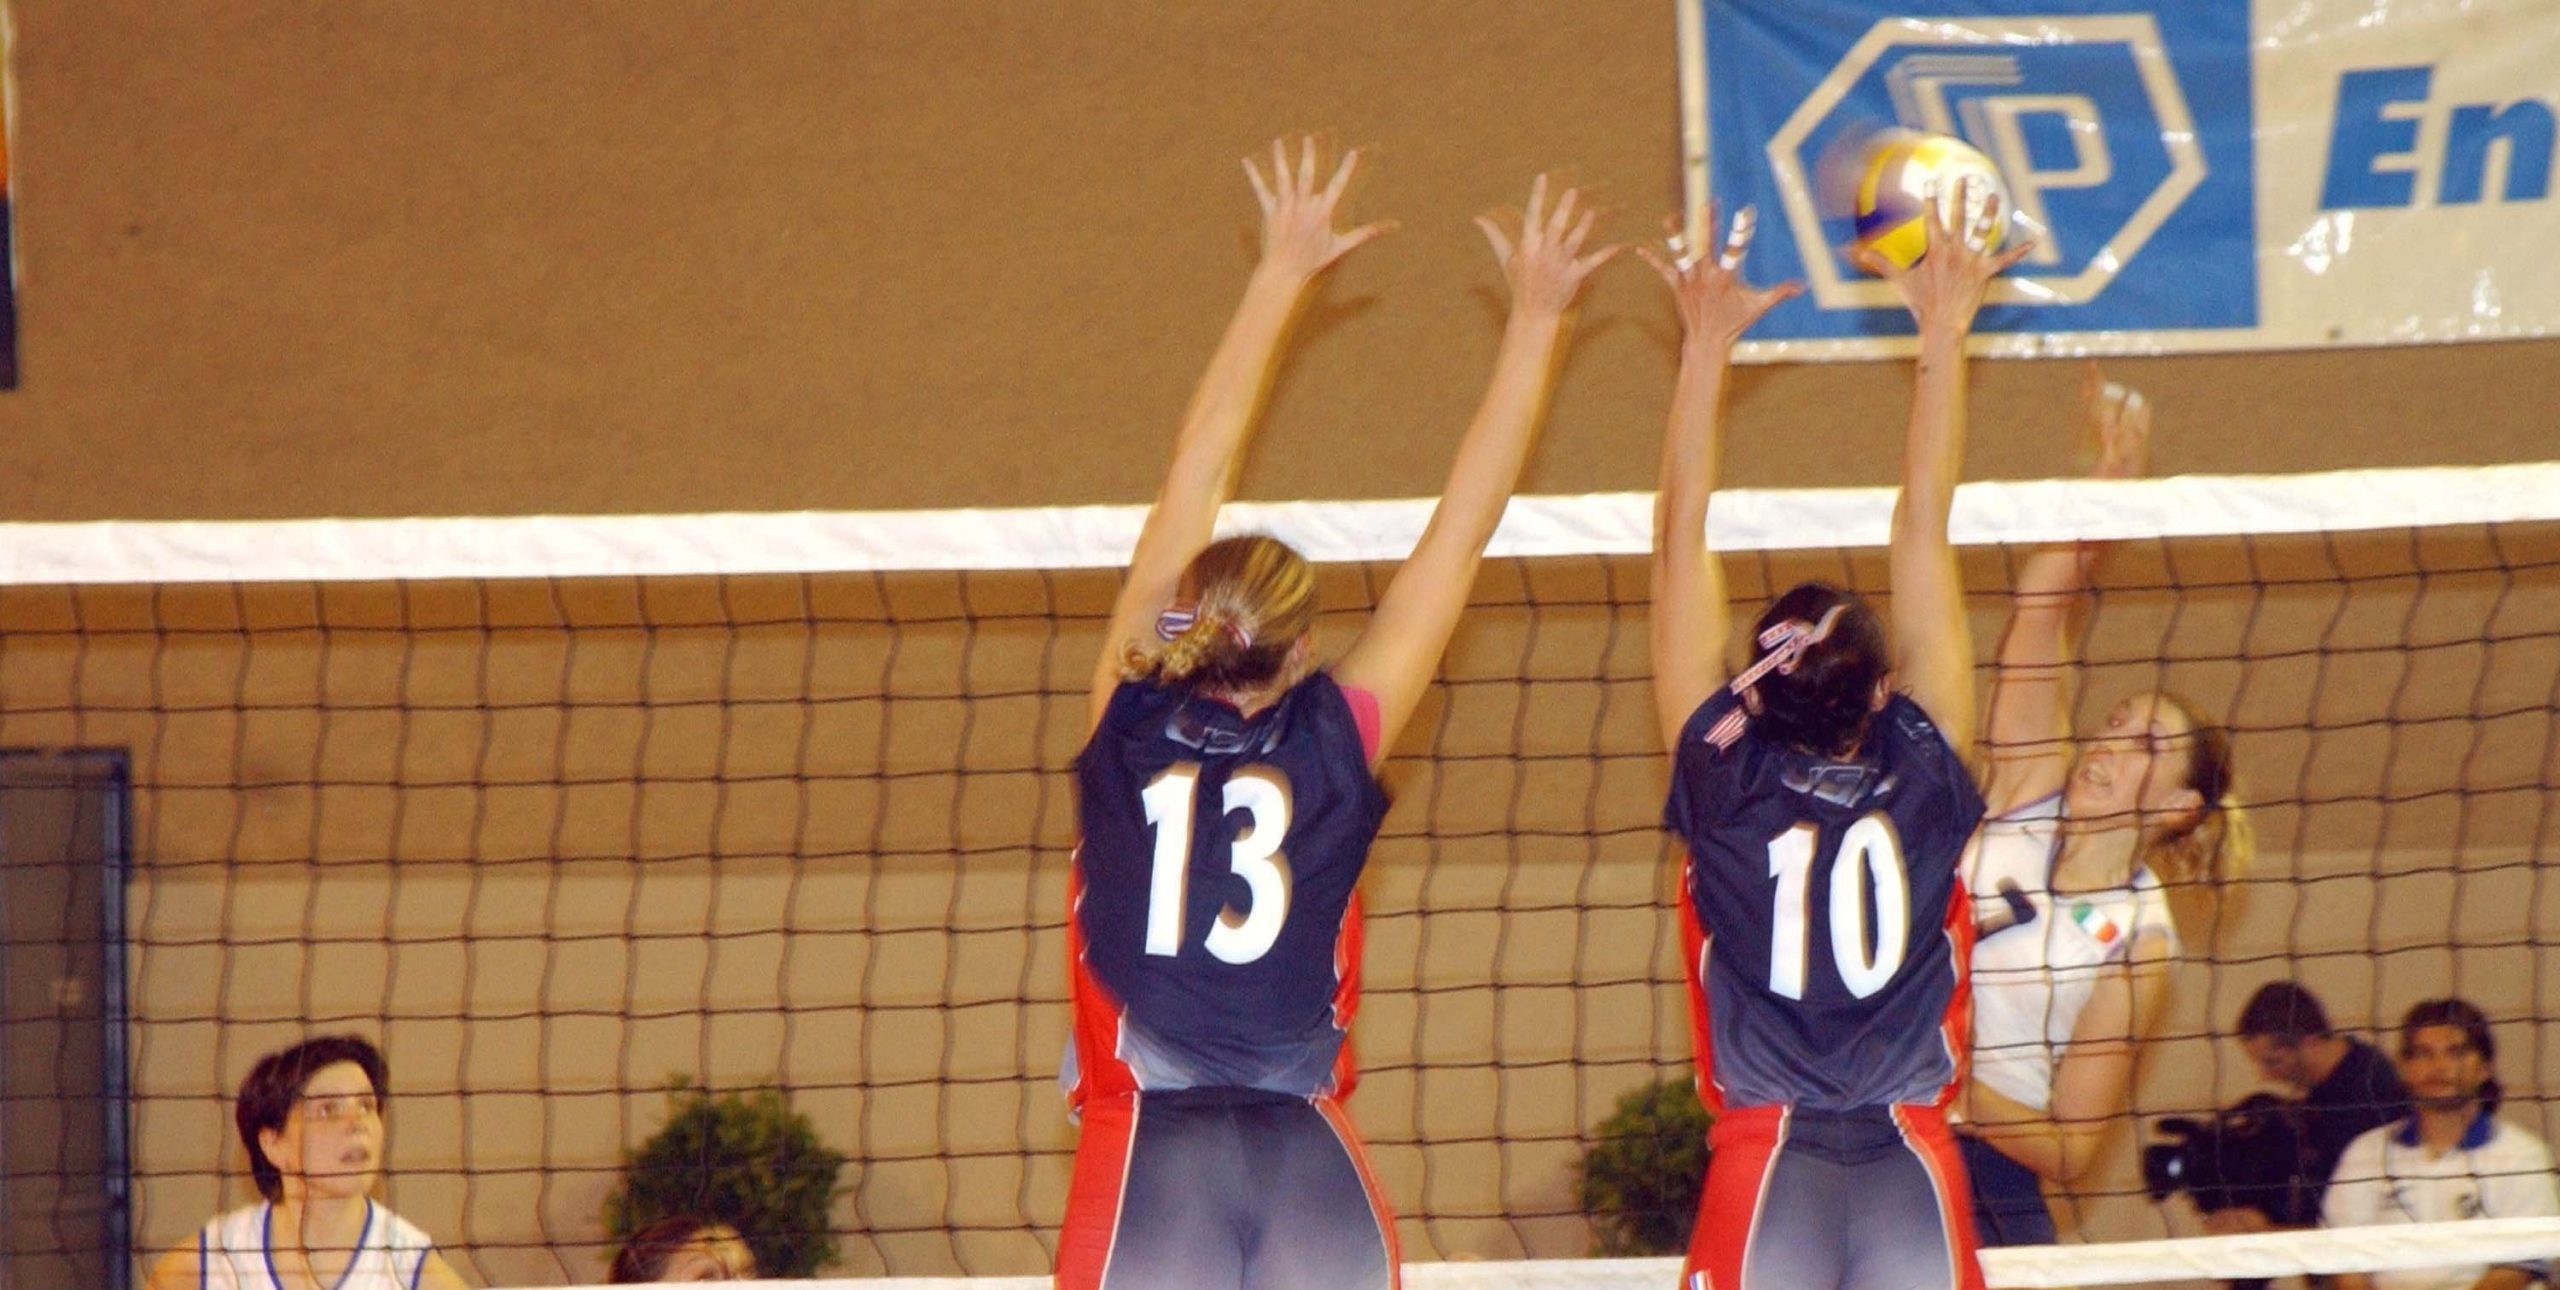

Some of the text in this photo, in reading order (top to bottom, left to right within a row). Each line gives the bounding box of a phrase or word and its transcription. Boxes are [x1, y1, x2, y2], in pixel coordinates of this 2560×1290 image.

[2318, 64, 2557, 209] En
[1141, 767, 1290, 965] 13
[1767, 814, 1909, 1001] 10
